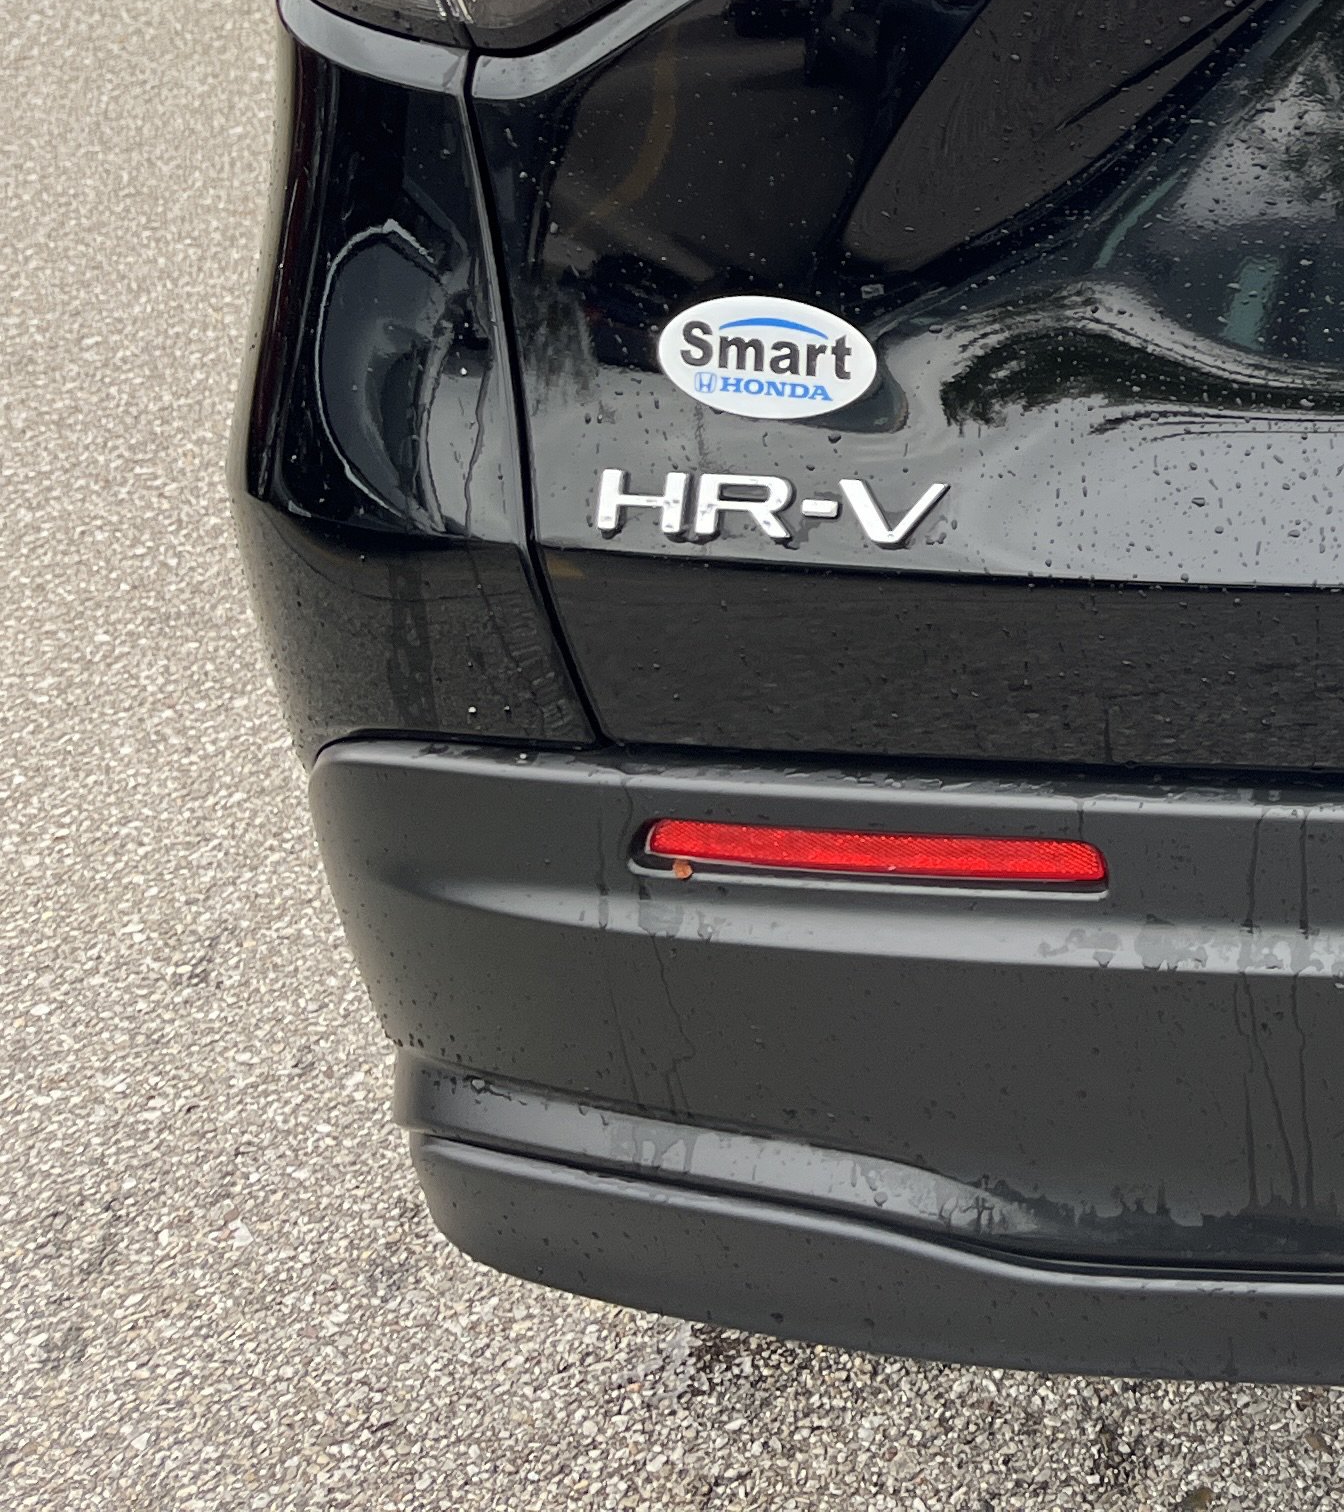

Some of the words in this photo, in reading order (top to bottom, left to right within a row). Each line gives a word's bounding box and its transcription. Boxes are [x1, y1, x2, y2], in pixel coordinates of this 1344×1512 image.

[679, 320, 852, 380] Smart
[720, 376, 834, 402] HONDA
[597, 468, 951, 545] HR-V
